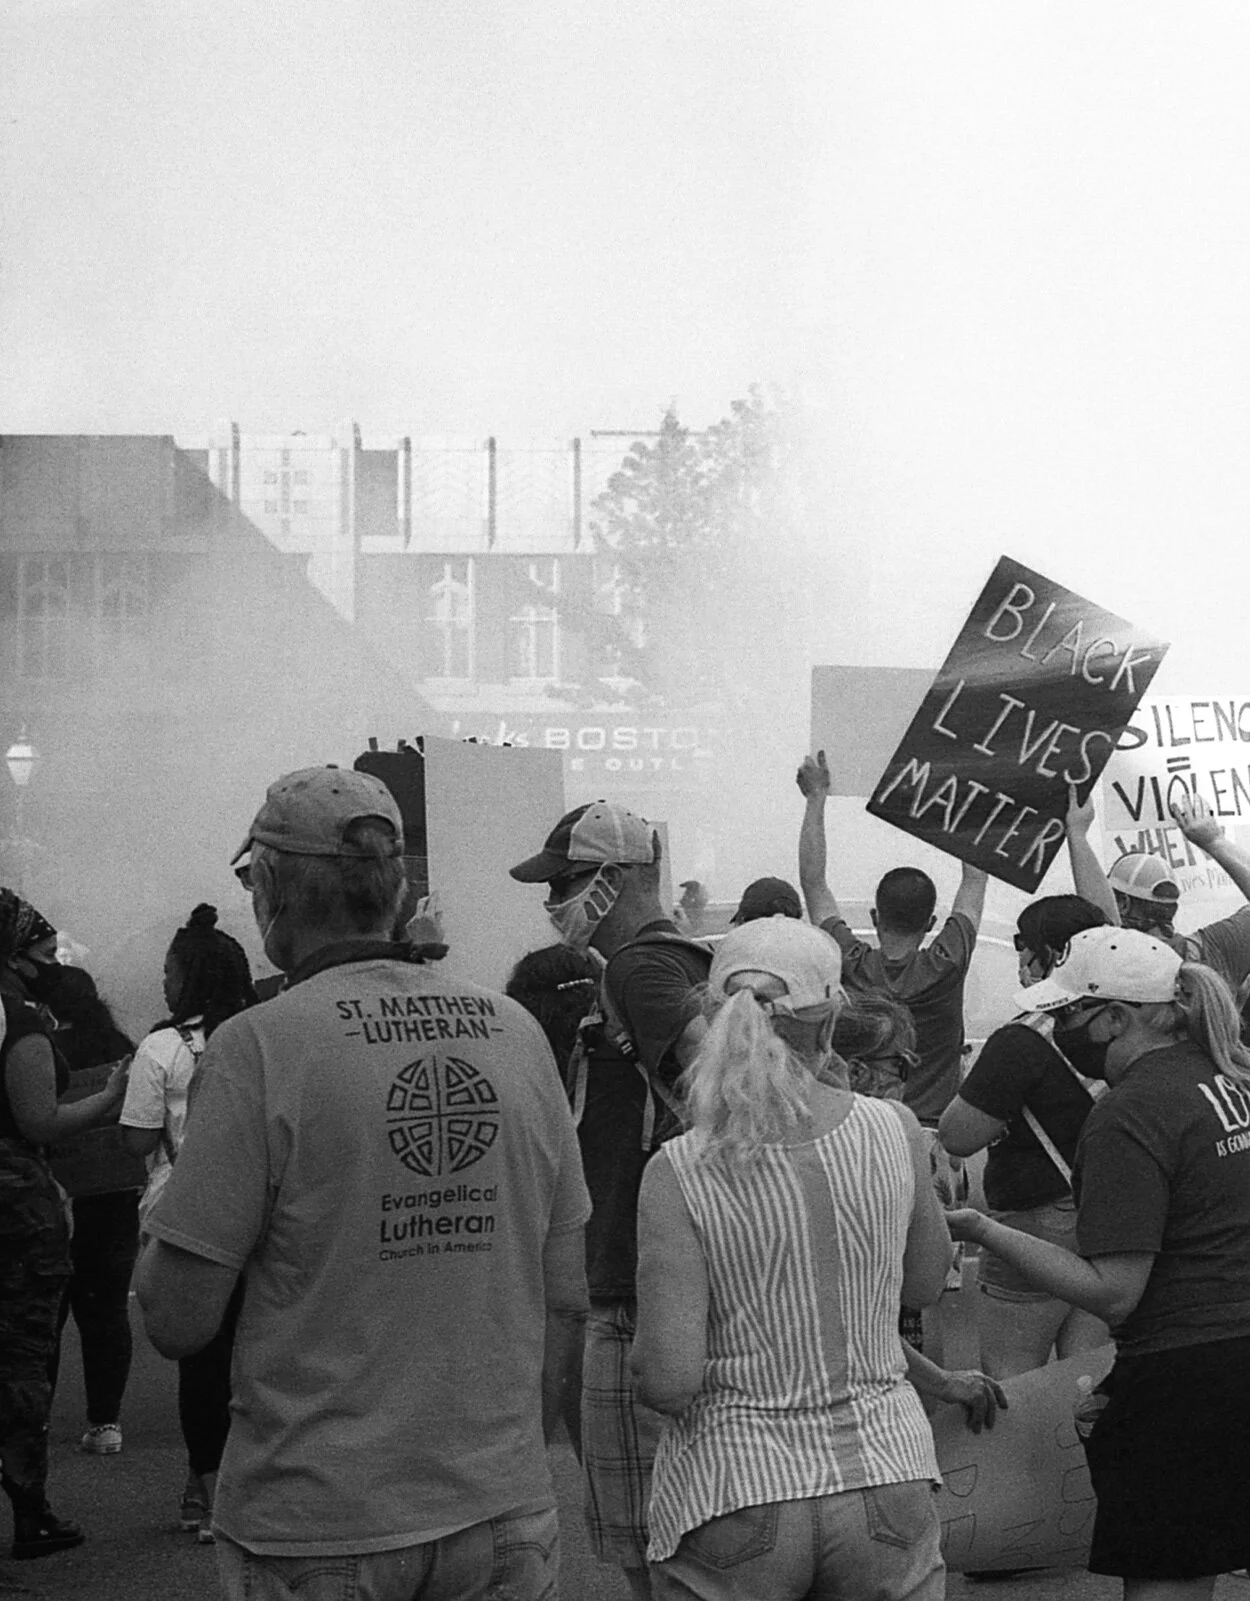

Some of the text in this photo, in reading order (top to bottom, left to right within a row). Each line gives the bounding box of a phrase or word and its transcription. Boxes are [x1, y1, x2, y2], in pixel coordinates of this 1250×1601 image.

[984, 582, 1150, 693] BLACK
[545, 726, 710, 749] BOSTO
[933, 679, 1112, 785] LIVES
[879, 757, 1064, 874] MATTER
[336, 996, 495, 1019] ST. MATTHEW
[381, 1184, 498, 1211] Evangelical
[380, 1213, 495, 1243] Lutheran
[379, 1244, 424, 1261] Church
[426, 1242, 439, 1255] in
